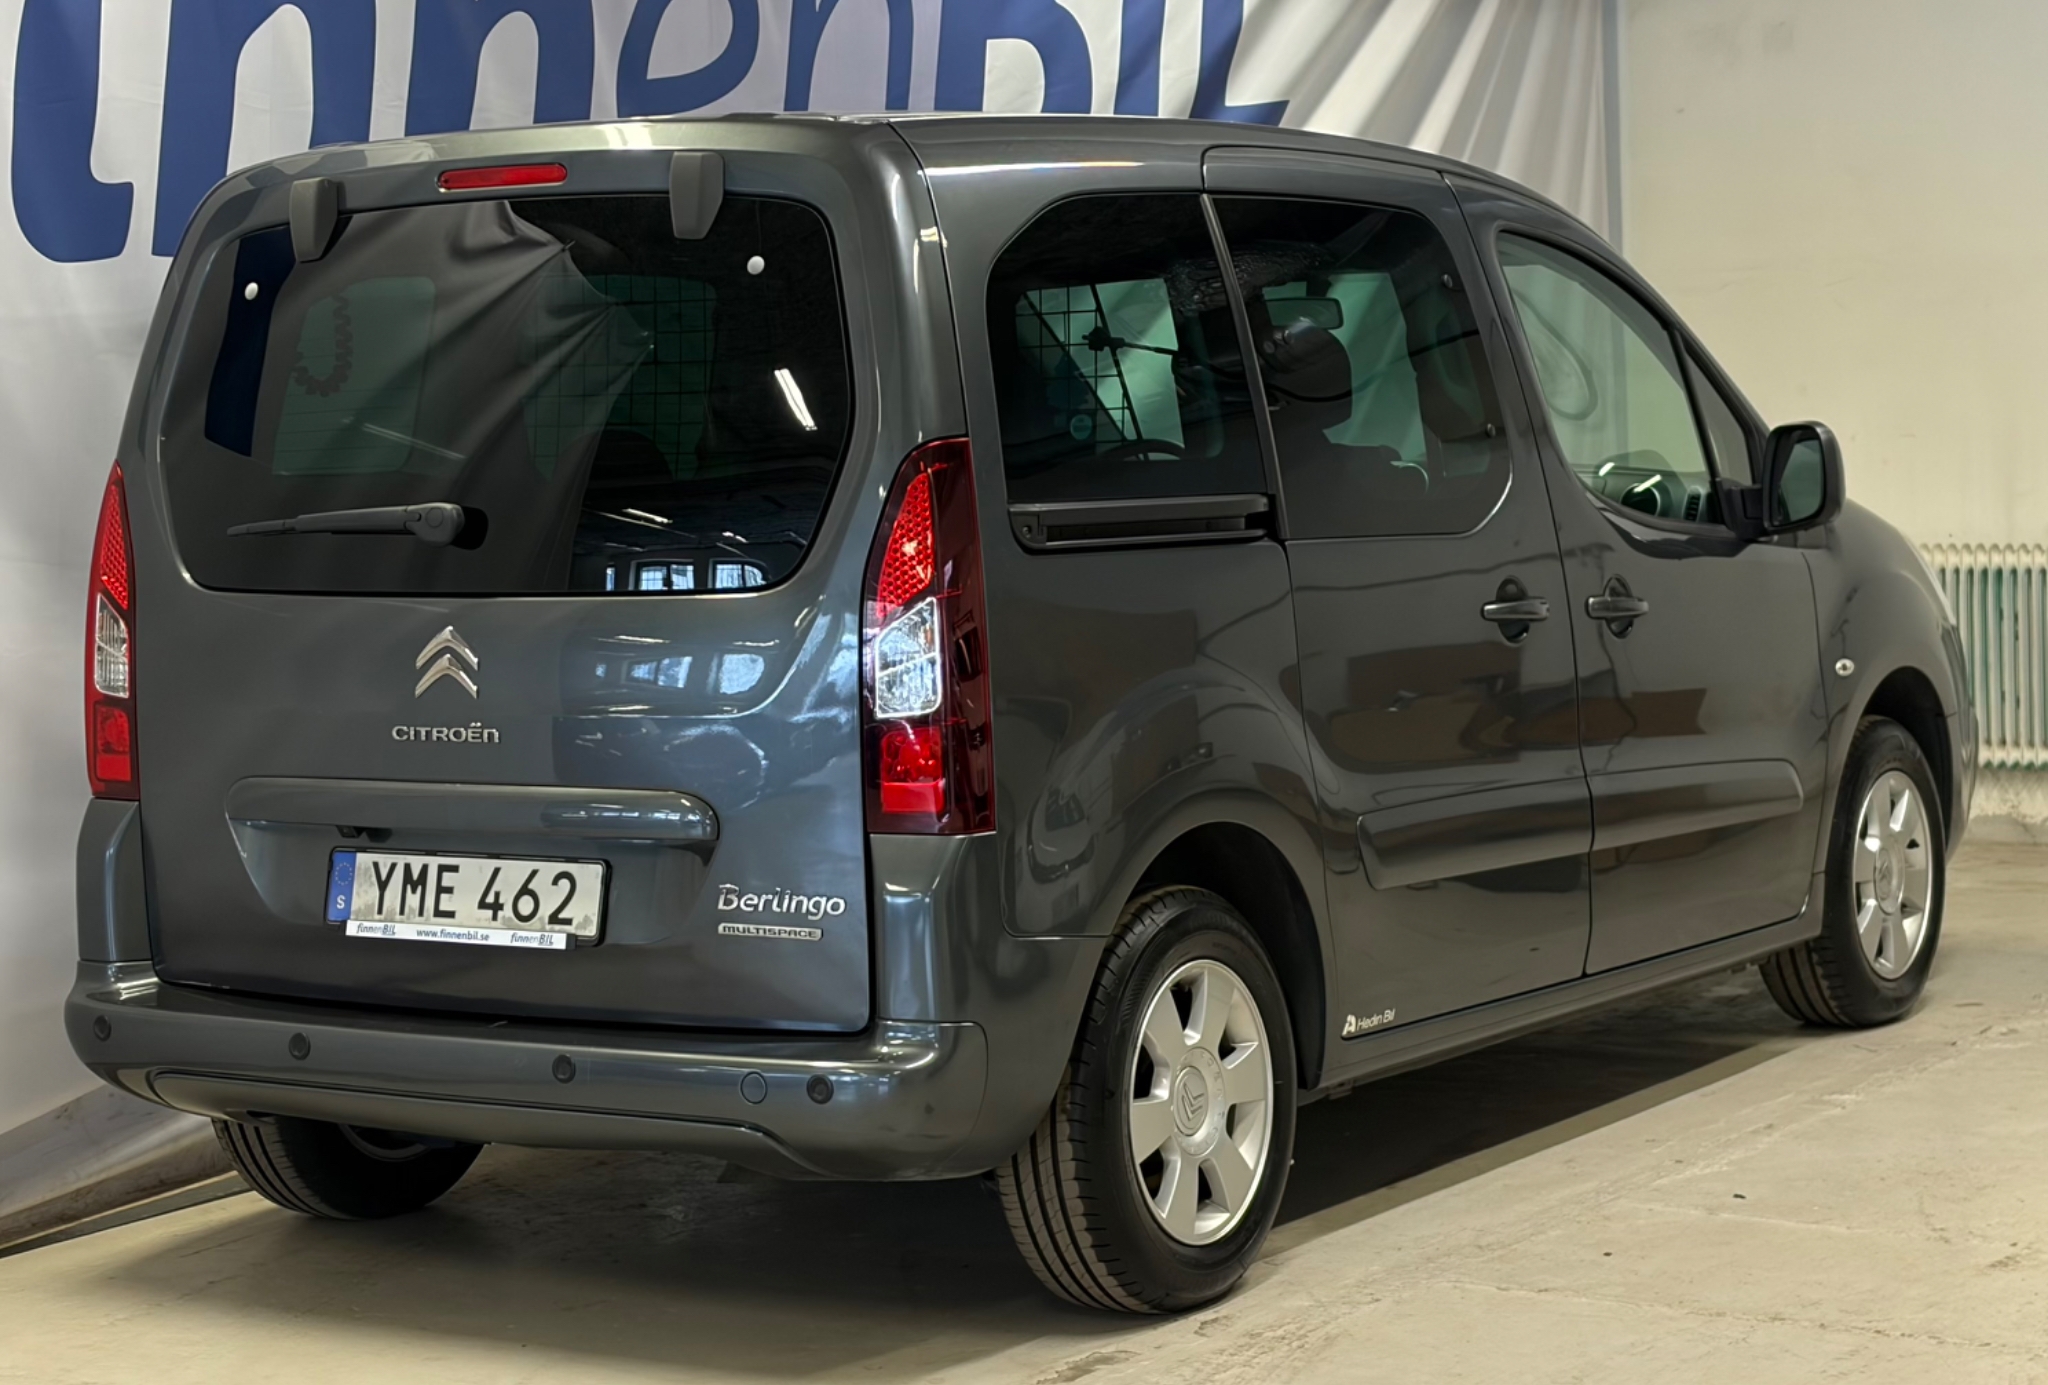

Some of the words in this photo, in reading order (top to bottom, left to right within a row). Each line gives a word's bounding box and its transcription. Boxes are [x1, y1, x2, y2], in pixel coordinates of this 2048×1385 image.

[336, 894, 346, 910] S
[372, 861, 460, 919] YME
[477, 866, 577, 926] 462
[717, 883, 847, 921] Berlingo
[416, 928, 490, 942] www.finnenbil.se
[722, 924, 818, 939] MULTISPACE
[1356, 1013, 1383, 1031] Hedin
